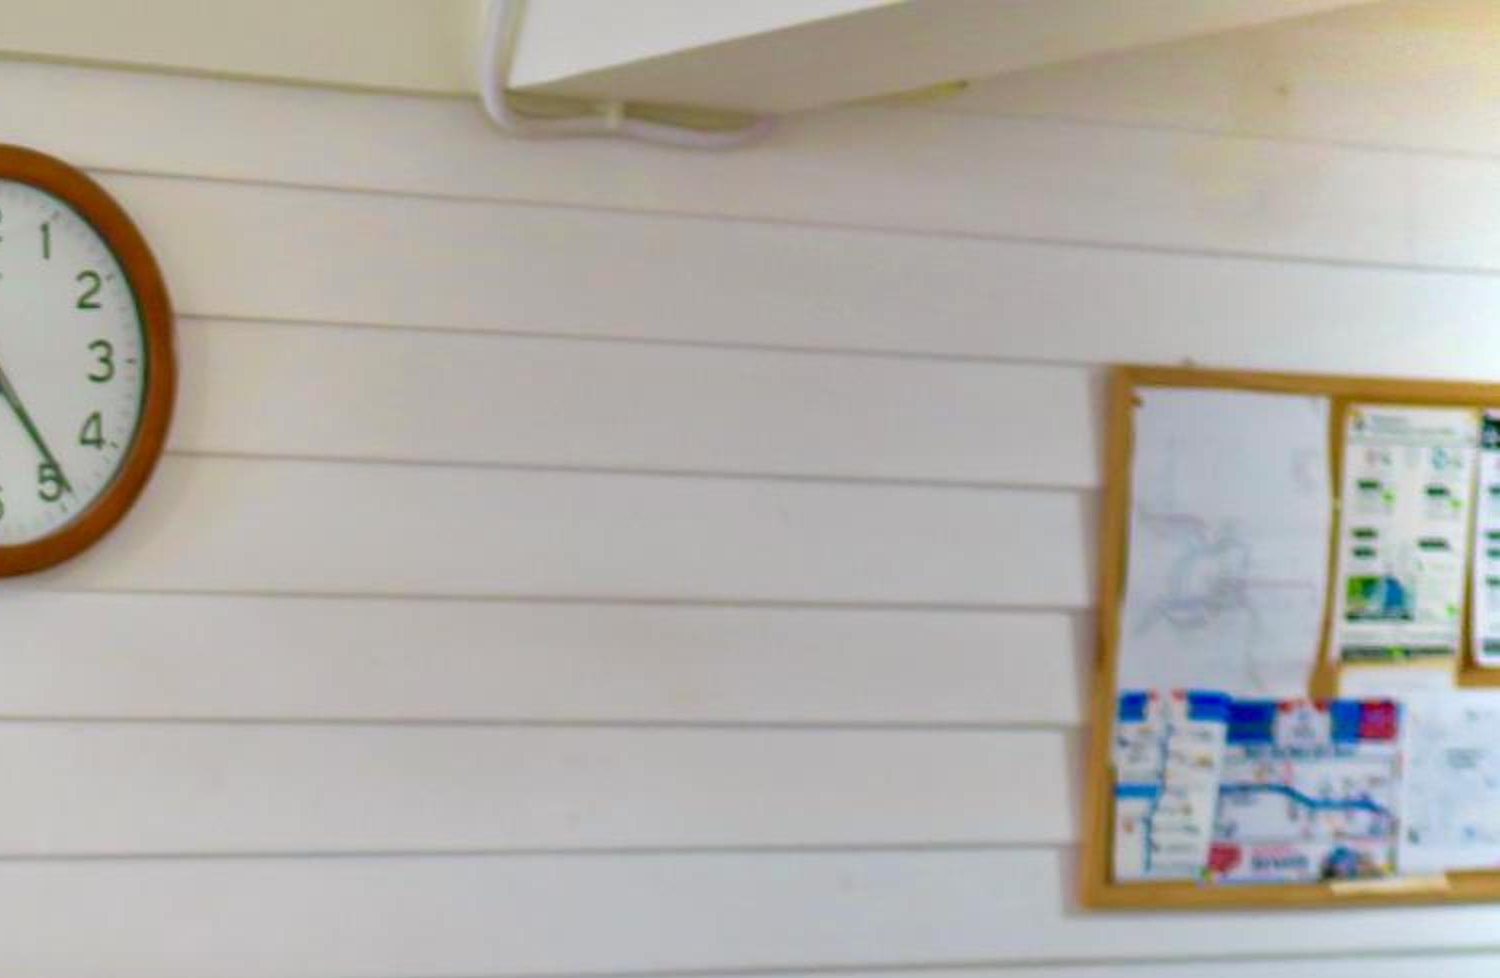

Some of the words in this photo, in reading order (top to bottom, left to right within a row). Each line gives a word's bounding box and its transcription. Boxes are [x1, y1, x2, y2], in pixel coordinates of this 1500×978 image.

[40, 222, 51, 260] 1
[76, 270, 102, 309] 2
[86, 339, 114, 383] 3
[79, 411, 105, 449] 4
[38, 464, 64, 502] 5
